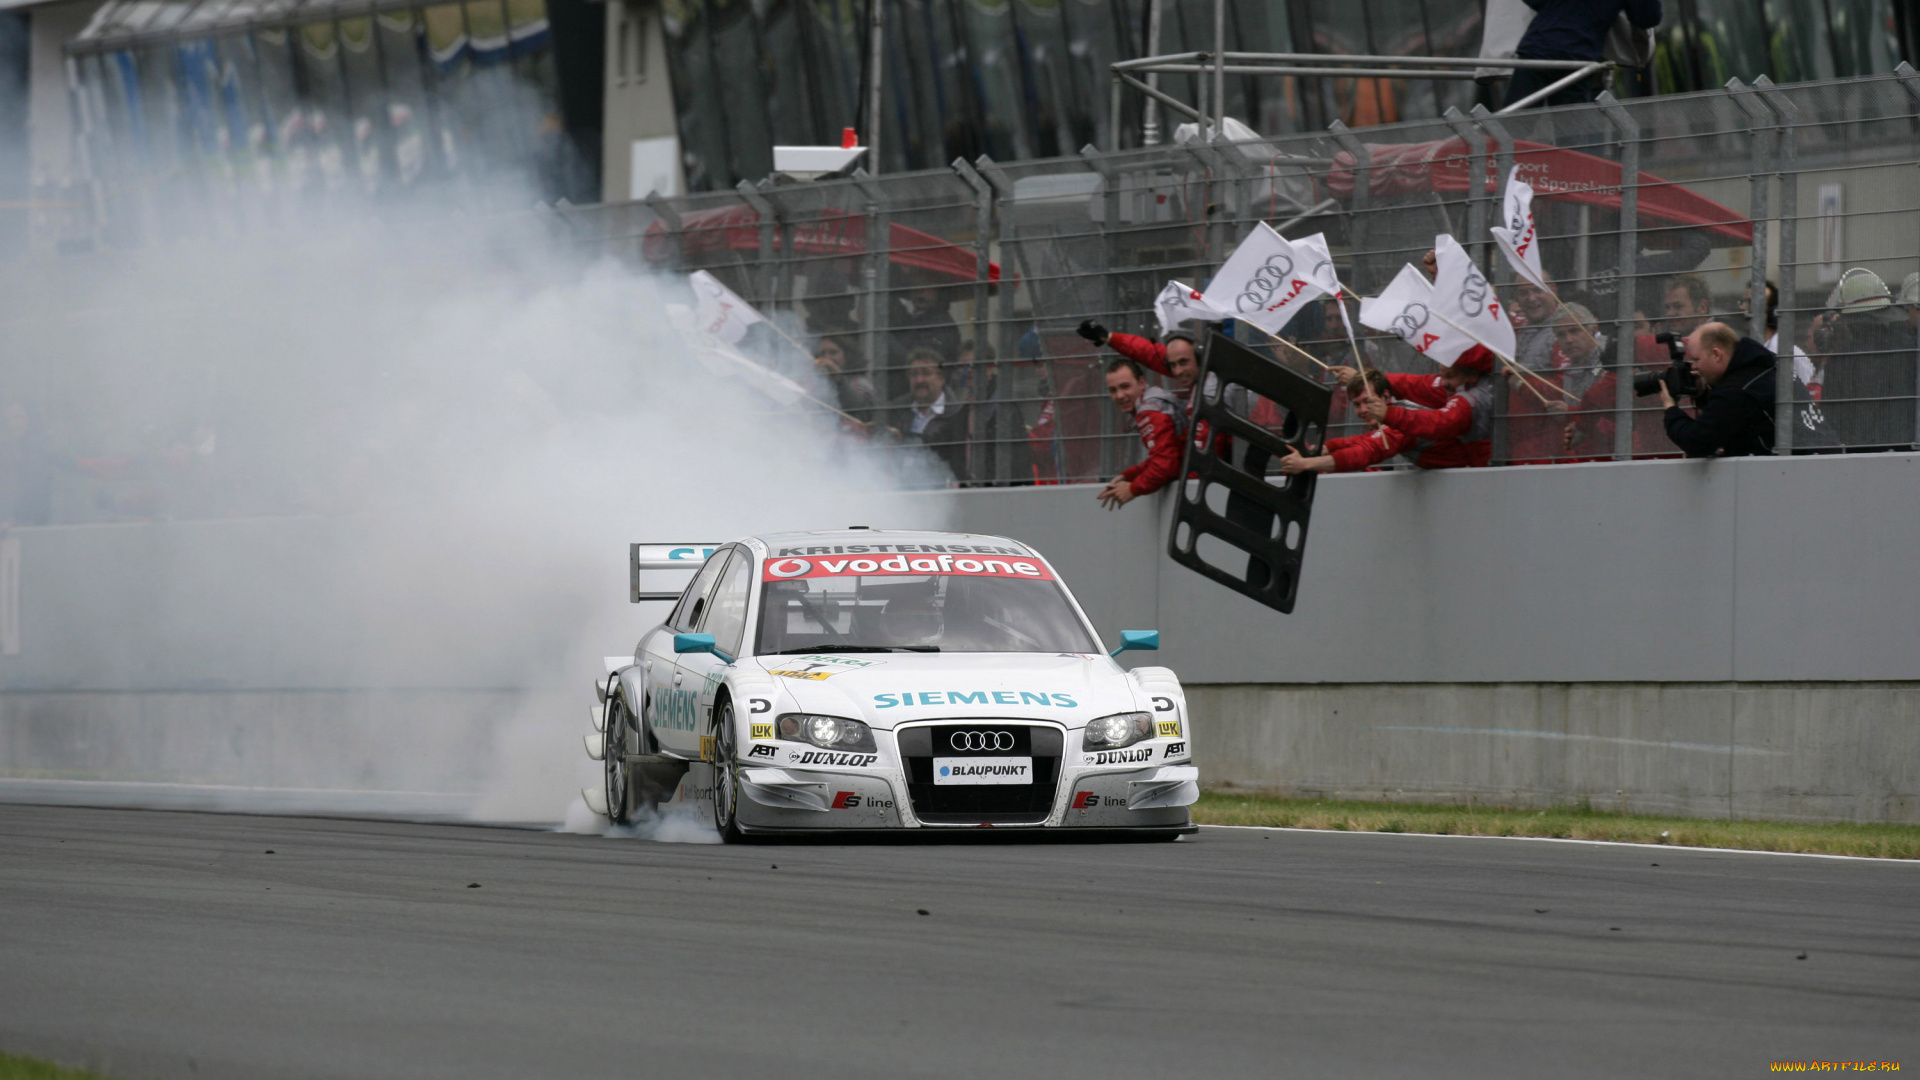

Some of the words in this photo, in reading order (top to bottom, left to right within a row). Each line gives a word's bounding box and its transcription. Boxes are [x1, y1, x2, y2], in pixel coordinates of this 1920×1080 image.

[779, 544, 1023, 557] KRISTENSEN
[819, 554, 1041, 577] vodafone
[873, 691, 1079, 709] SIEMENS
[654, 687, 698, 732] SIEMENS
[748, 744, 780, 757] ABT
[1095, 748, 1153, 765] DUNLOP
[1164, 741, 1186, 758] ABT
[799, 751, 878, 767] DUNLOP
[952, 765, 1028, 776] BLAUPUNKT
[843, 795, 862, 808] S
[867, 796, 894, 808] line
[1083, 795, 1100, 806] S
[1104, 795, 1127, 807] line
